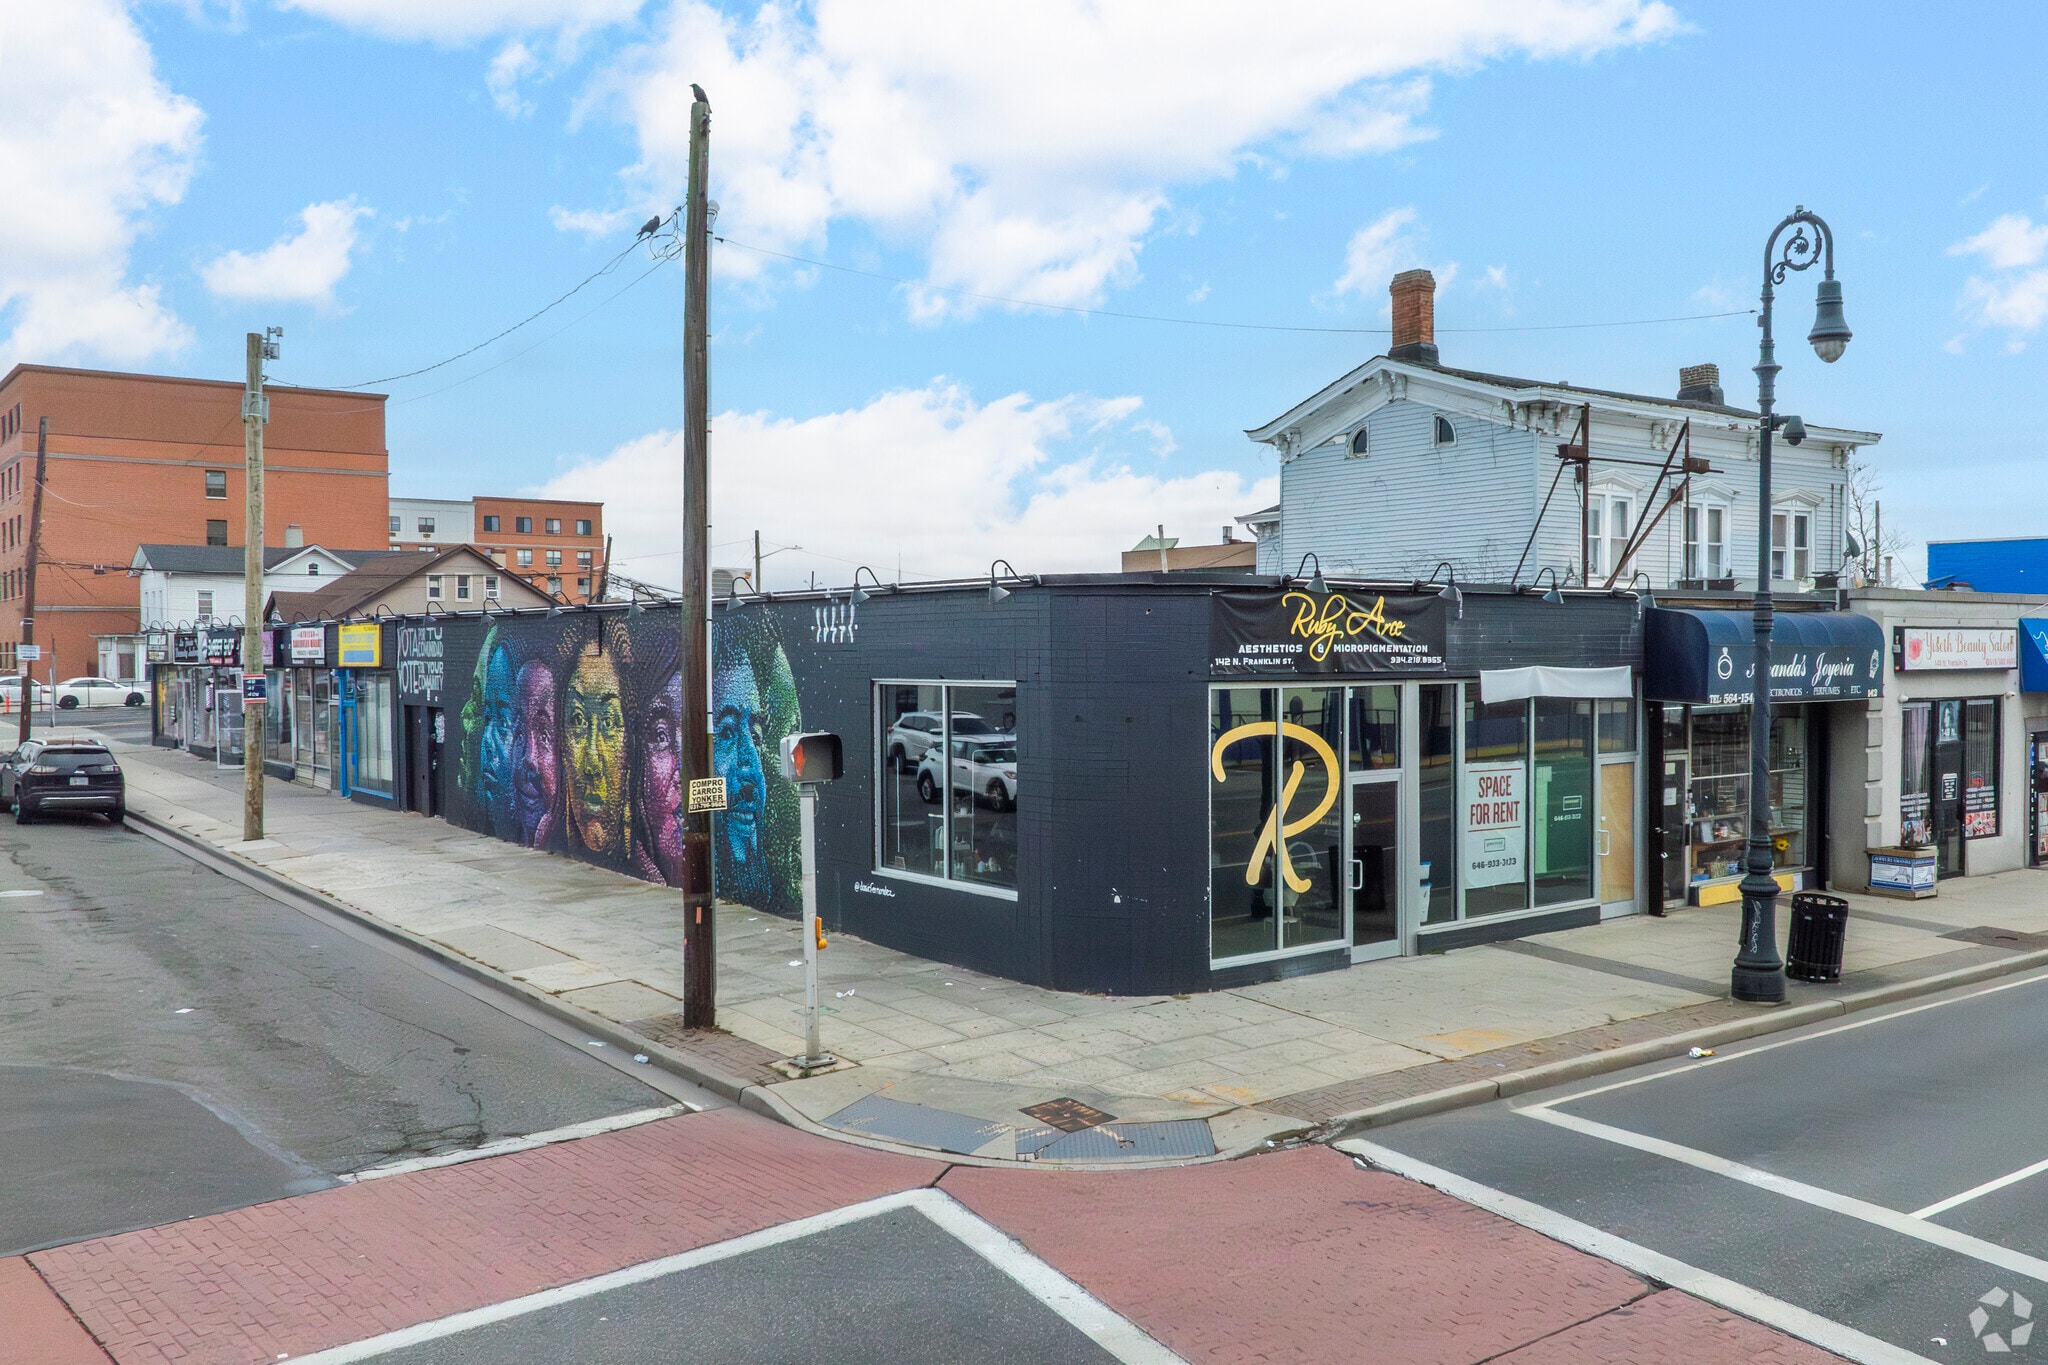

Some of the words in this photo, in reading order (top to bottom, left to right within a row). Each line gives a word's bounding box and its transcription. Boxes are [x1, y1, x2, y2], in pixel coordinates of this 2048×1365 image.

[426, 627, 443, 640] TU
[1282, 592, 1347, 662] Ruby
[397, 628, 418, 657] VOTA
[1238, 644, 1303, 654] AESTHETICS
[1333, 644, 1428, 653] MICROPIGMENTATION
[1957, 632, 1987, 660] Beauty
[1989, 632, 2014, 653] Salon
[1215, 657, 1231, 666] 142
[1232, 657, 1241, 666] N.
[1811, 652, 1855, 687] Joyeria
[1723, 693, 1755, 703] 564-154
[692, 779, 723, 789] COMPRO
[1478, 775, 1512, 799] SPACE
[692, 787, 723, 797] CARROS
[692, 795, 724, 804] YONKER
[1470, 803, 1490, 826] FOR
[1493, 801, 1520, 823] RENT
